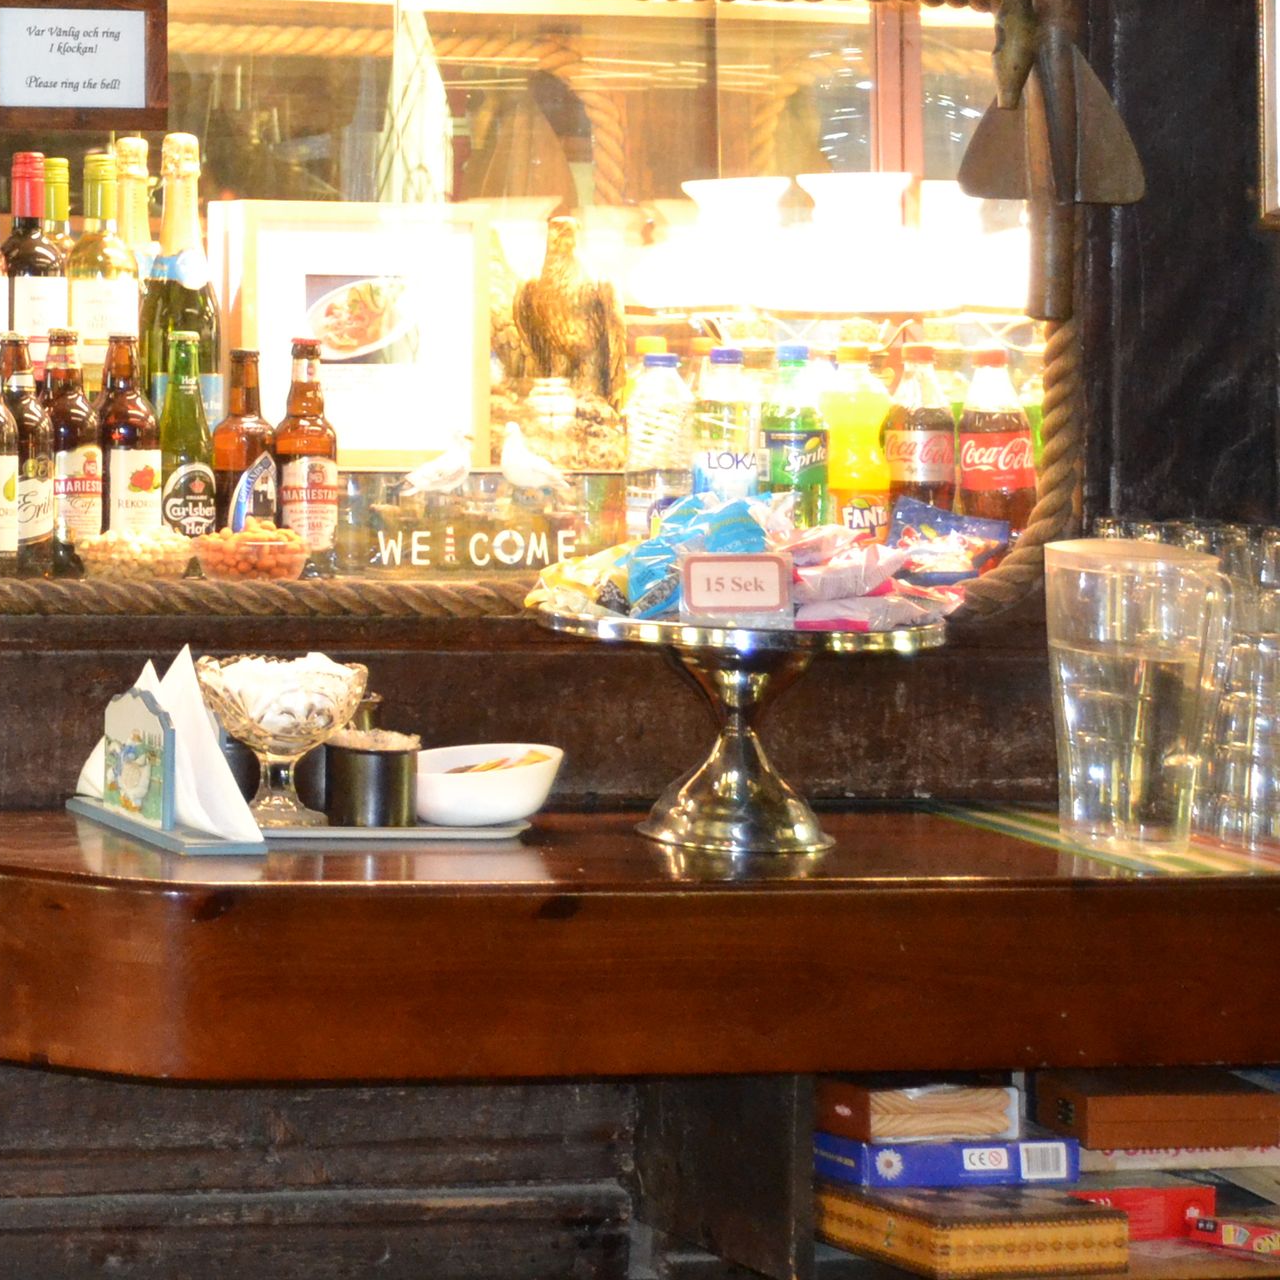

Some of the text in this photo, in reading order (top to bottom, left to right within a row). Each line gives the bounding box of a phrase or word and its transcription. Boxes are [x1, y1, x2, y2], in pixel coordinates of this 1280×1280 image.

[26, 25, 46, 37] Var
[83, 27, 98, 38] och
[102, 28, 120, 41] ring
[57, 42, 98, 56] klockan!
[25, 76, 121, 92] Please ring the bell!
[707, 451, 758, 470] LOKA
[184, 521, 209, 535] Hof
[705, 576, 765, 592] 15 Sek
